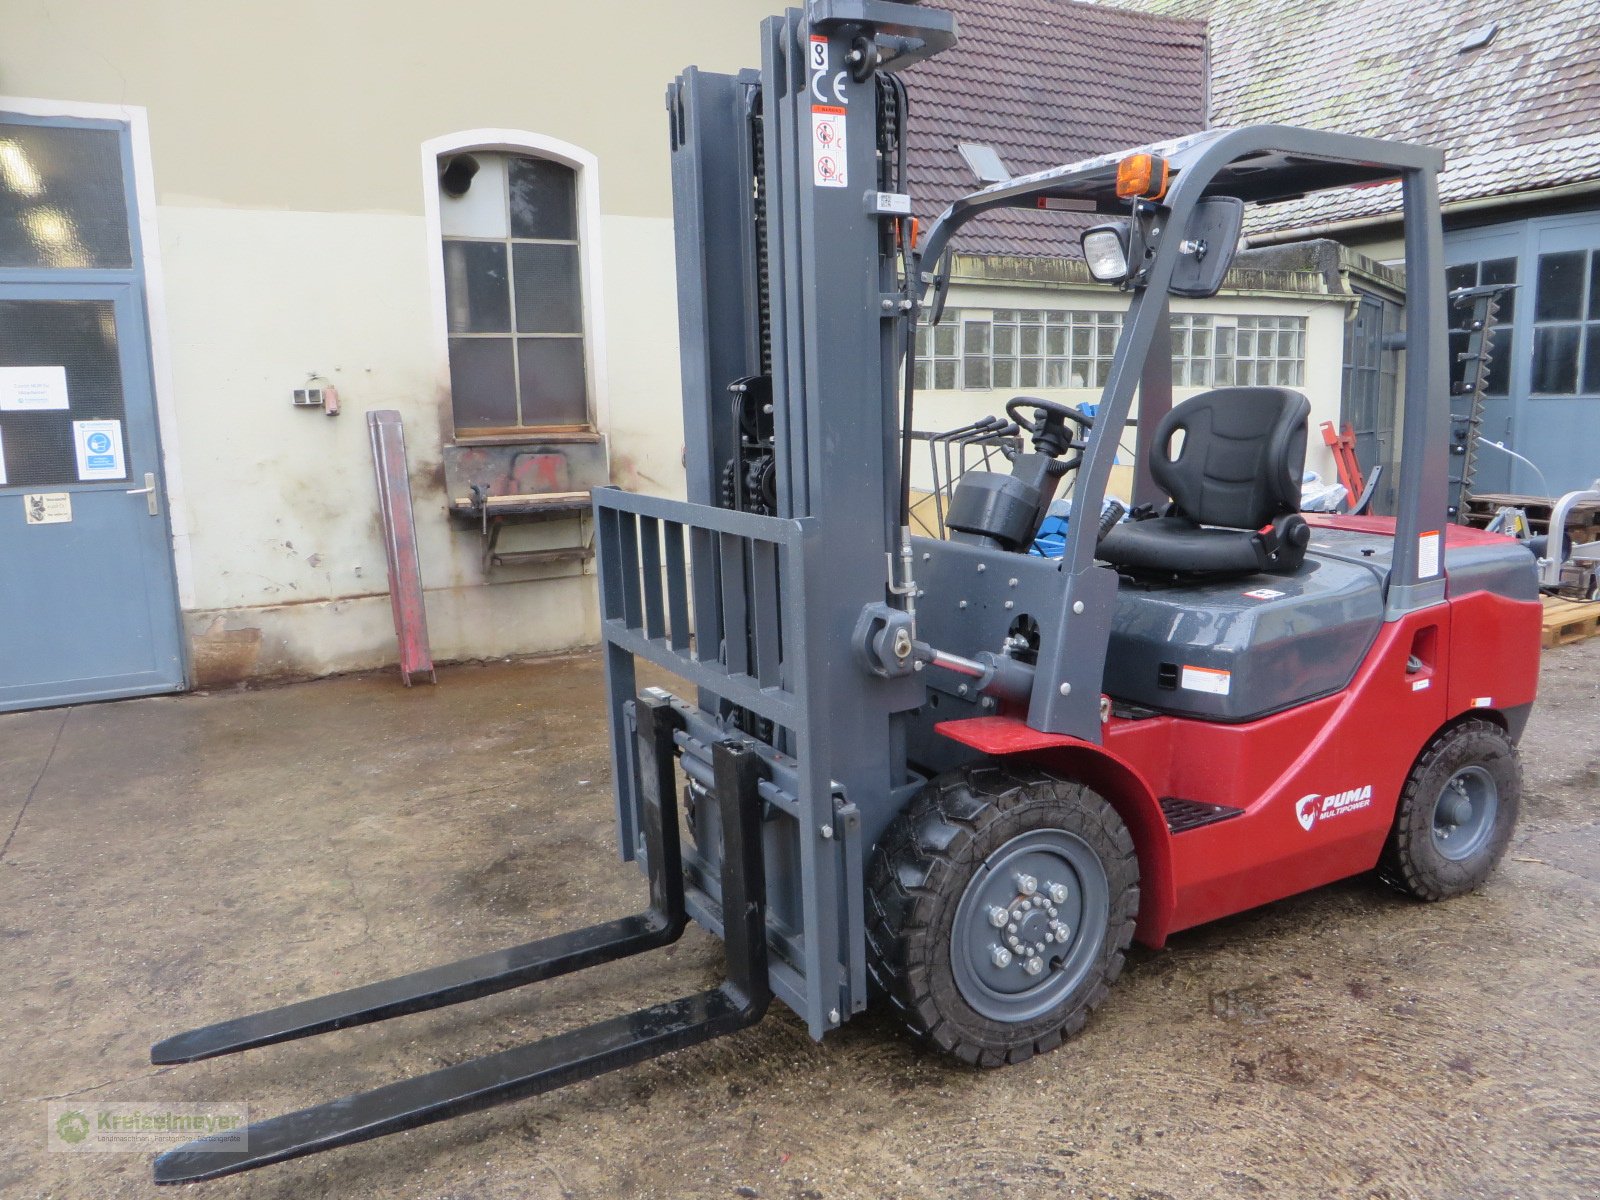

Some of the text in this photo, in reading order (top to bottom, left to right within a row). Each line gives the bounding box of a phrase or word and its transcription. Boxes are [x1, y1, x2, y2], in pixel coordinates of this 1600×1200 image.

[812, 70, 848, 104] CE
[1319, 799, 1370, 820] MULTIPOWER
[1321, 785, 1371, 811] PUMA
